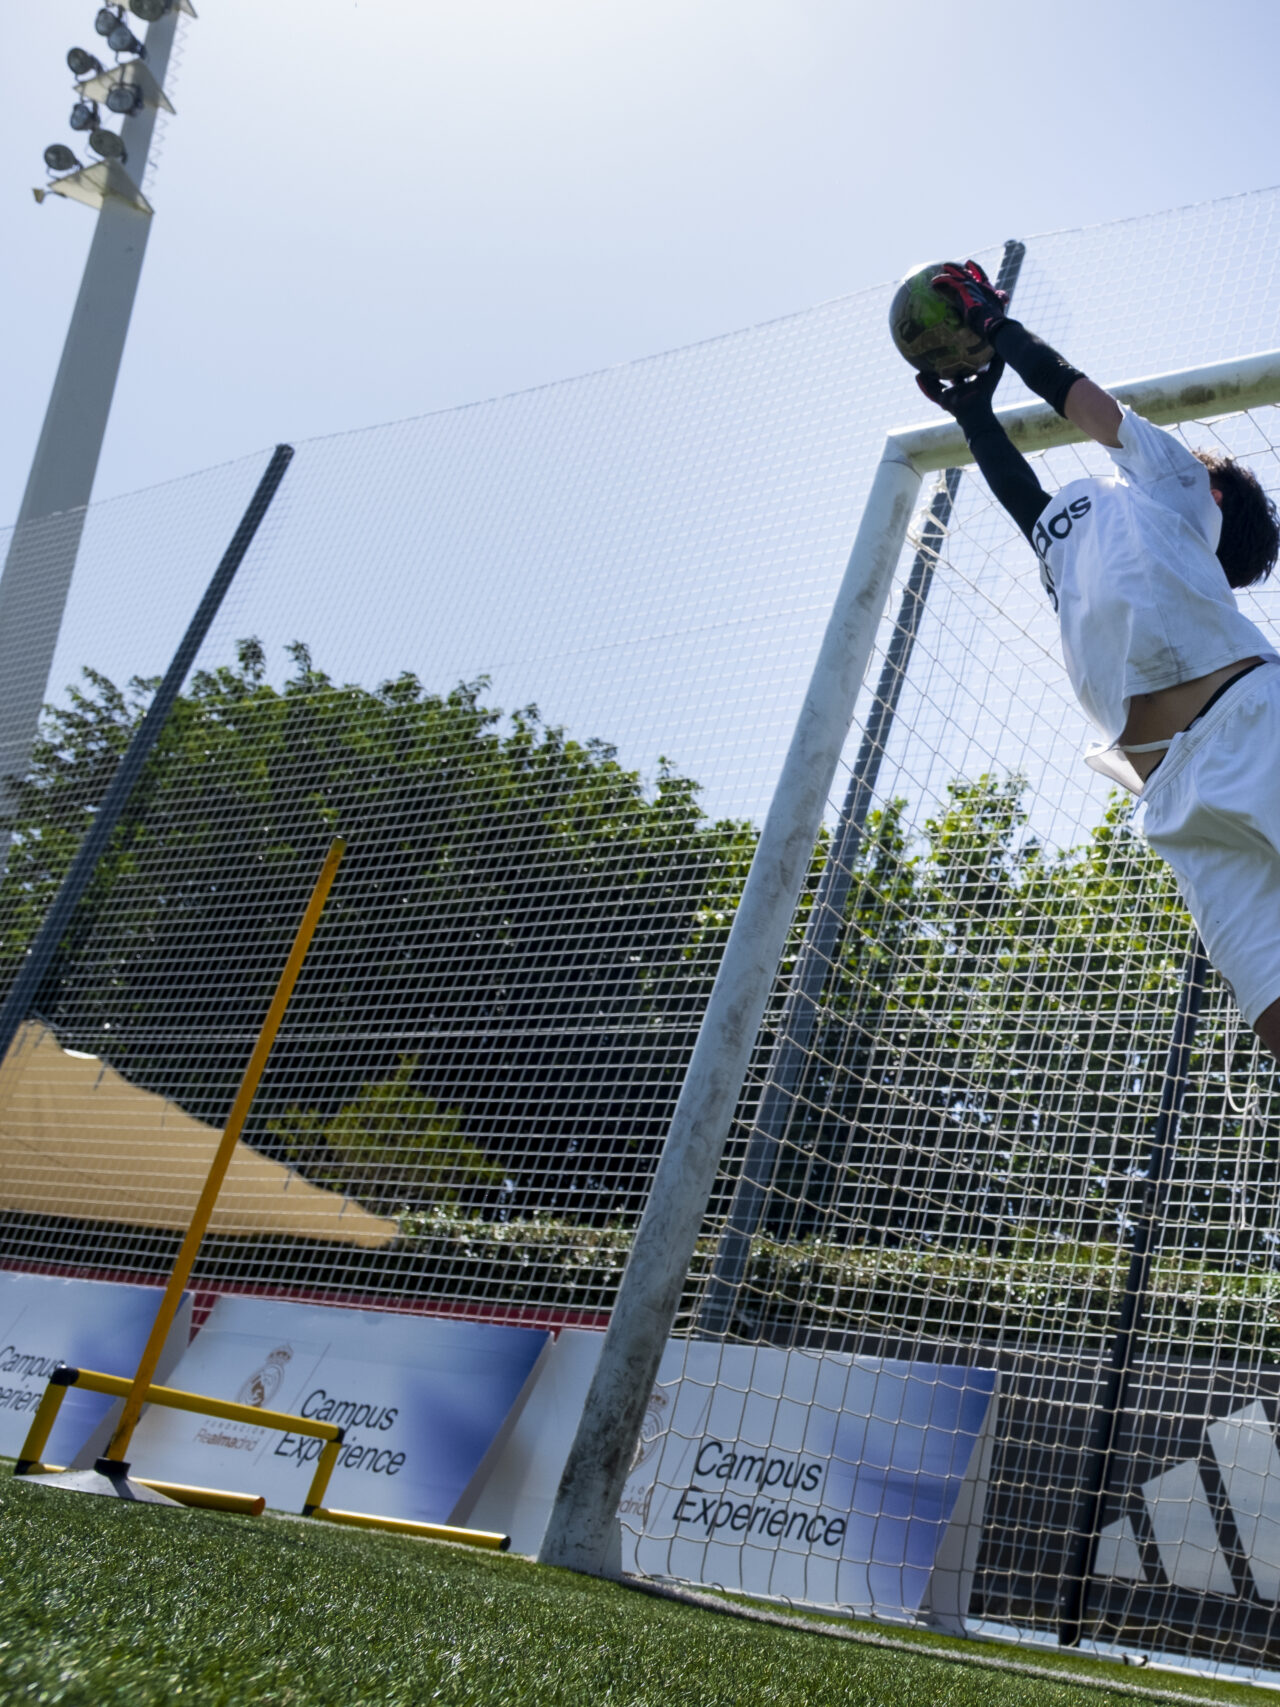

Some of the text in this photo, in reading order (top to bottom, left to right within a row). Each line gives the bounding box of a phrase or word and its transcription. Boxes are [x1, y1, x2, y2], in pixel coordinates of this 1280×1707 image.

[301, 1389, 399, 1432] Campus
[274, 1432, 406, 1475] Exprience
[695, 1441, 822, 1492] Campus
[672, 1484, 847, 1546] Experience
